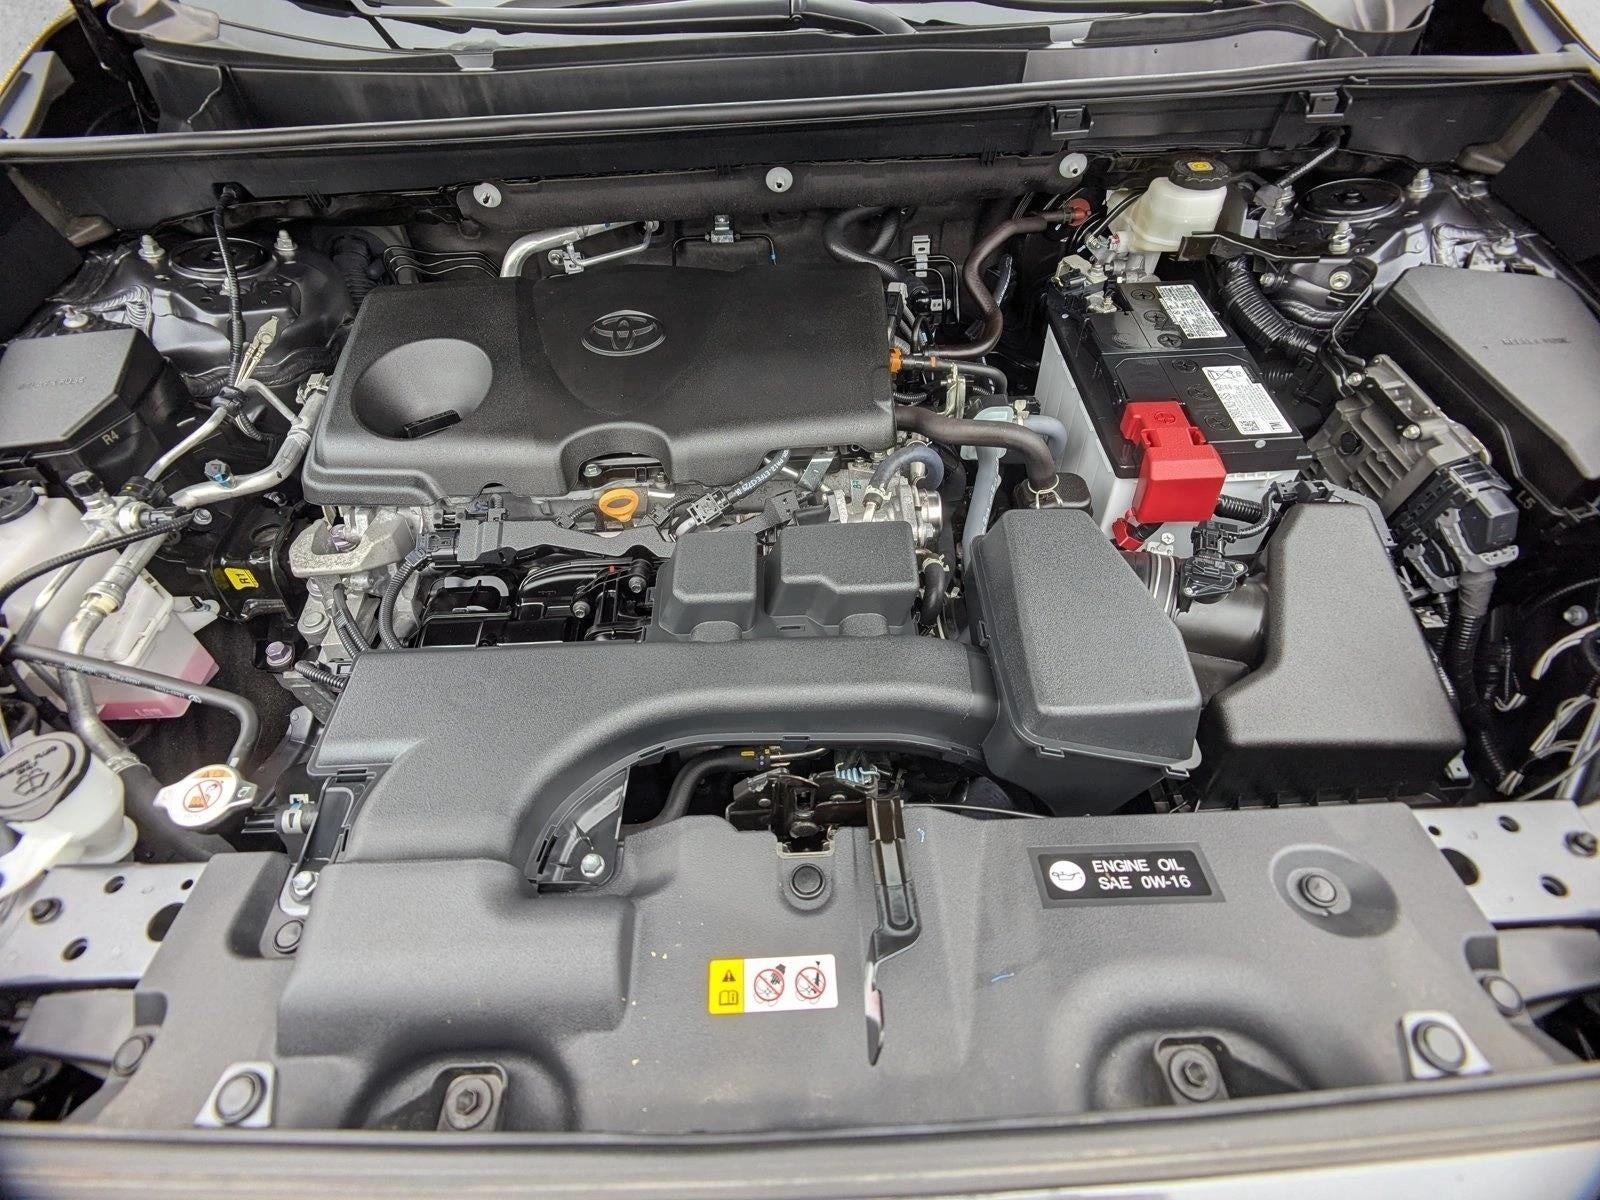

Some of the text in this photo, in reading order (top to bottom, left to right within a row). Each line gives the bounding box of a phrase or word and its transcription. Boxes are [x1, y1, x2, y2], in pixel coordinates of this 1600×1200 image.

[102, 430, 119, 446] R4
[1091, 858, 1185, 873] ENGINE OIL
[1099, 874, 1191, 890] SAE 0W-16
